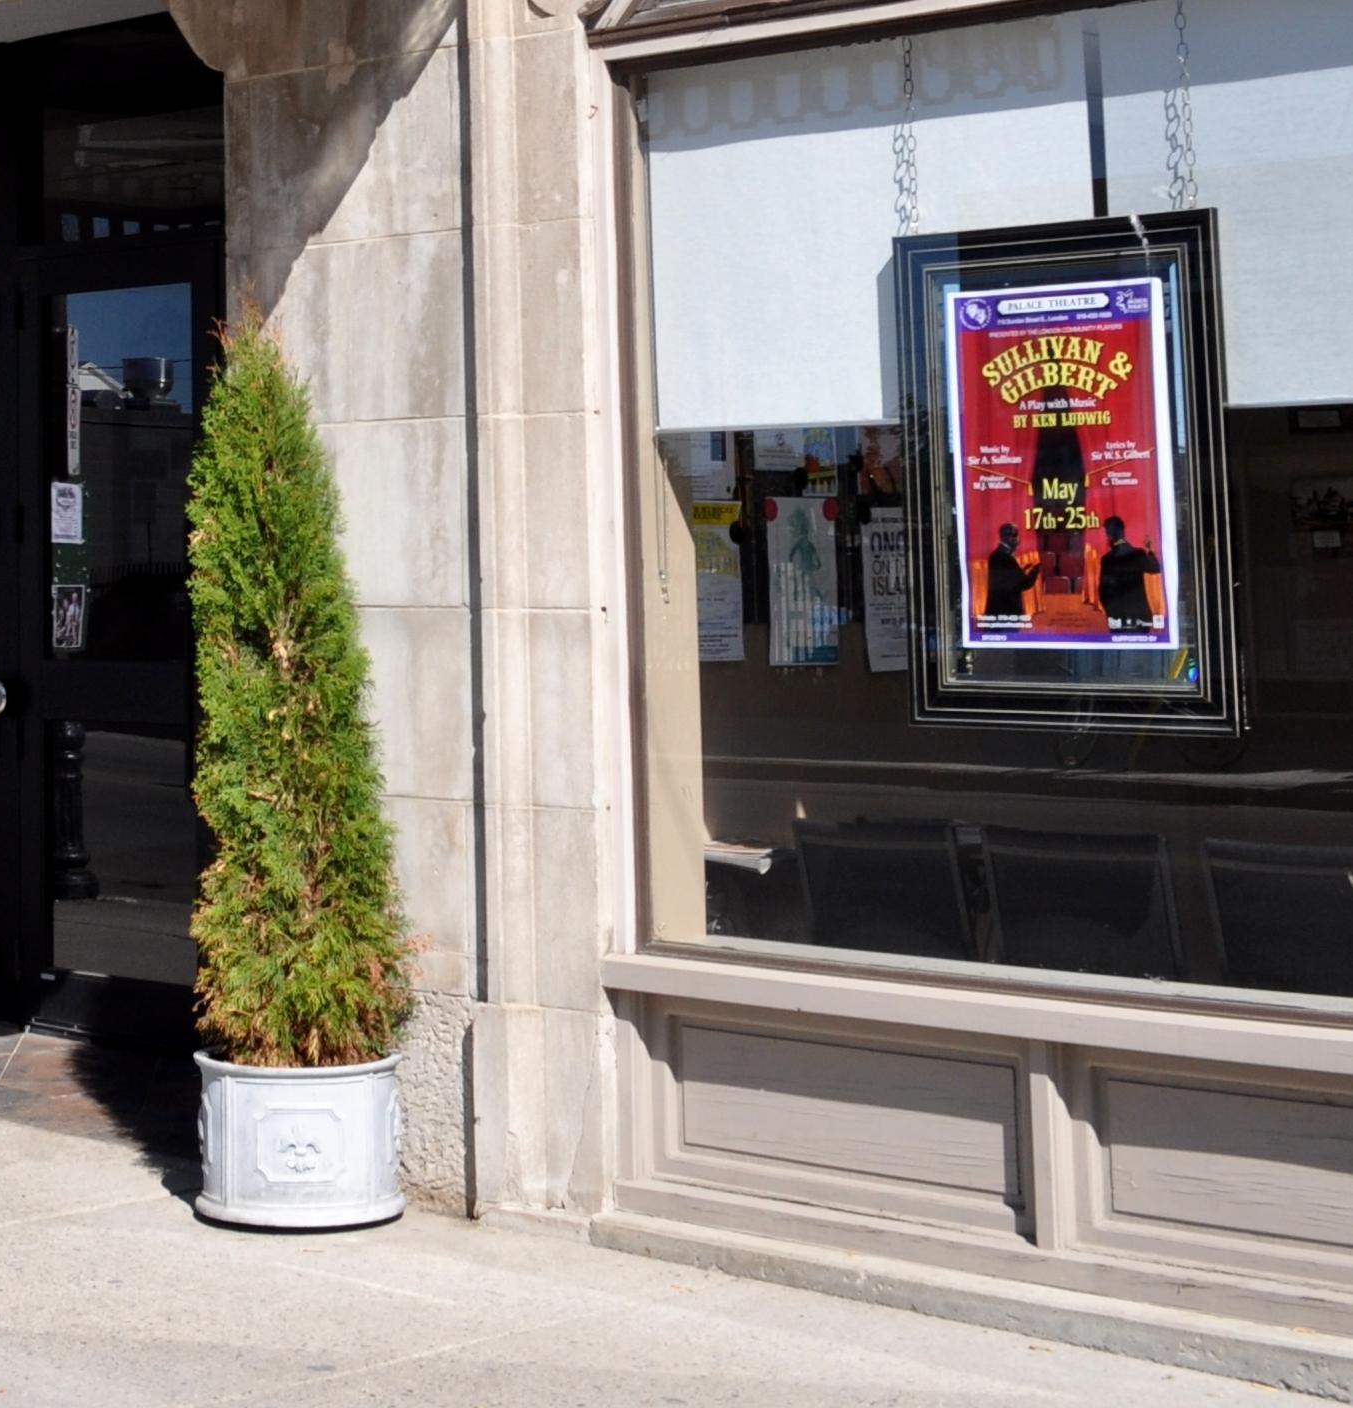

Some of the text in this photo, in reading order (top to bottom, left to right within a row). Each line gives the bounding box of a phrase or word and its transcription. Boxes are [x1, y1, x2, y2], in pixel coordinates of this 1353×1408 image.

[1007, 296, 1097, 312] PALACE THEATRE
[982, 335, 1133, 388] SULLIVAN &
[1000, 362, 1119, 404] GILBERT
[1019, 396, 1098, 412] A Play with Music
[1013, 411, 1112, 429] BY KEN LUDWIG
[979, 444, 1011, 456] Music by
[1106, 439, 1136, 451] Lyrics by
[967, 455, 980, 466] Sir
[991, 454, 1022, 465] Sullivan
[1091, 450, 1104, 461] Sir
[1123, 448, 1151, 460] Gilbert
[1042, 478, 1079, 504] May
